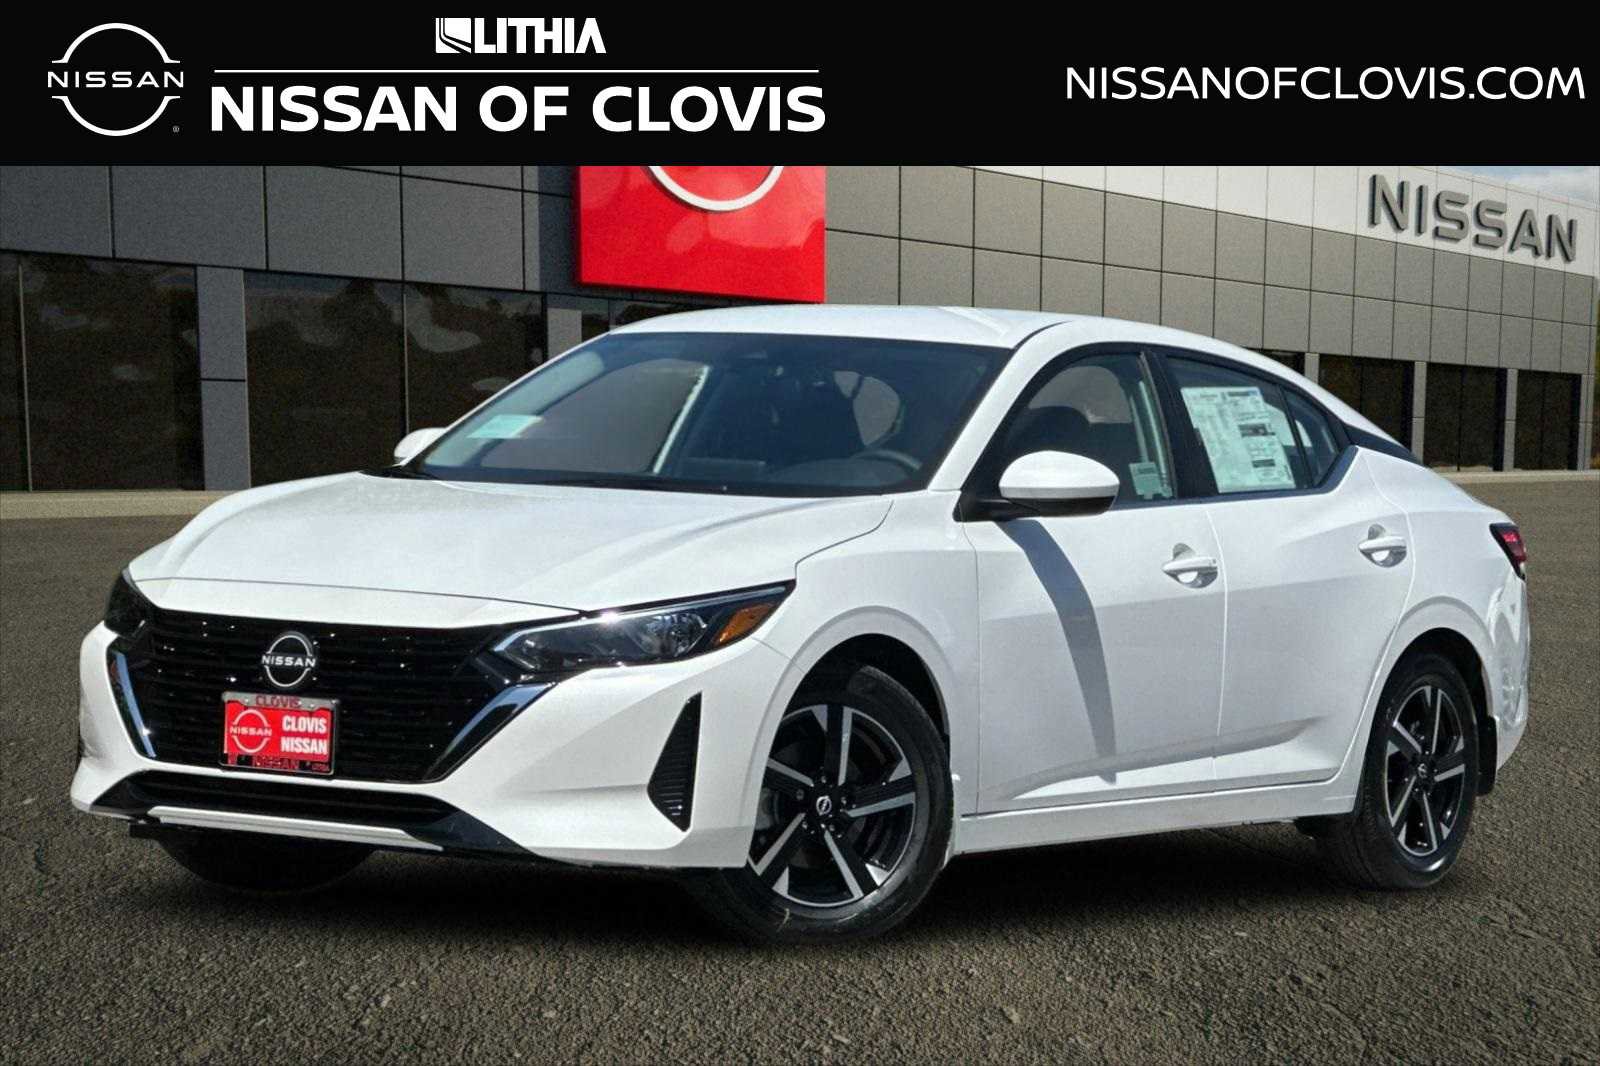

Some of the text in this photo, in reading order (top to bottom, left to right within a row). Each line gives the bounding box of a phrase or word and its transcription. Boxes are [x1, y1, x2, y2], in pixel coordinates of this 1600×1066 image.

[1367, 173, 1578, 264] NISSAN
[261, 655, 317, 668] NISSAN
[229, 725, 273, 737] NISSAN
[282, 715, 328, 734] CLOVIS
[280, 736, 329, 755] NISSAN
